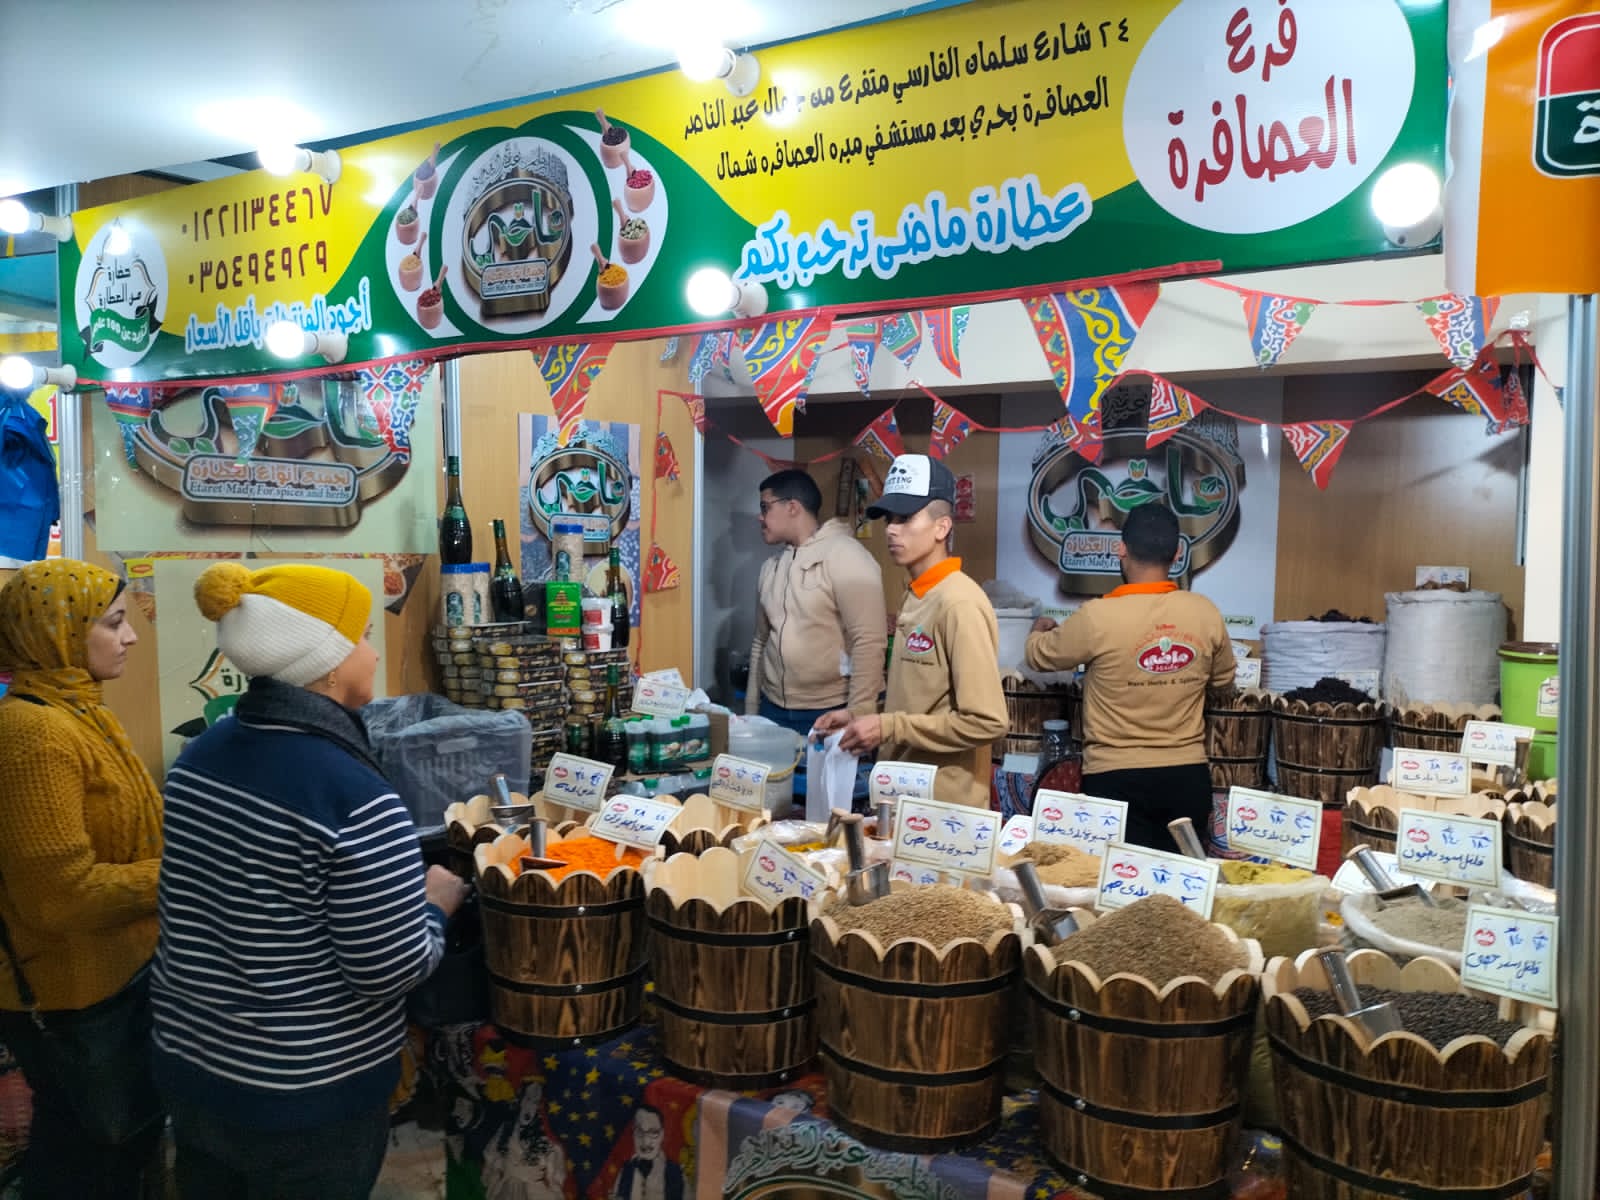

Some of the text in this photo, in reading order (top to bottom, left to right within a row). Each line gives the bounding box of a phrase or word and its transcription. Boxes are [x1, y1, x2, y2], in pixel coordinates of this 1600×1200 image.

[965, 35, 1029, 76] سلمان
[1034, 21, 1092, 61] شارع
[1226, 0, 1297, 82] فرع
[810, 85, 835, 108] من
[838, 68, 890, 104] متفرع
[893, 45, 960, 104] الفارسي
[684, 98, 726, 140] الناصر
[730, 98, 759, 130] عبد
[970, 104, 1018, 139] بحري
[1023, 75, 1110, 127] العصافرة
[940, 114, 965, 141] بعد
[1167, 75, 1357, 202] العصافرة
[717, 149, 757, 181] شمال
[181, 183, 333, 242] ٠١٢٢١١٣٤٤٦٧
[976, 182, 1086, 246] عطارة
[188, 239, 328, 293] ٠٣٥٤٩٤٩٢٩
[739, 217, 791, 281] بكم
[797, 217, 869, 280] ترحب
[187, 304, 232, 350] الأسعار
[233, 296, 263, 347] بأقل
[328, 281, 372, 335] أجود
